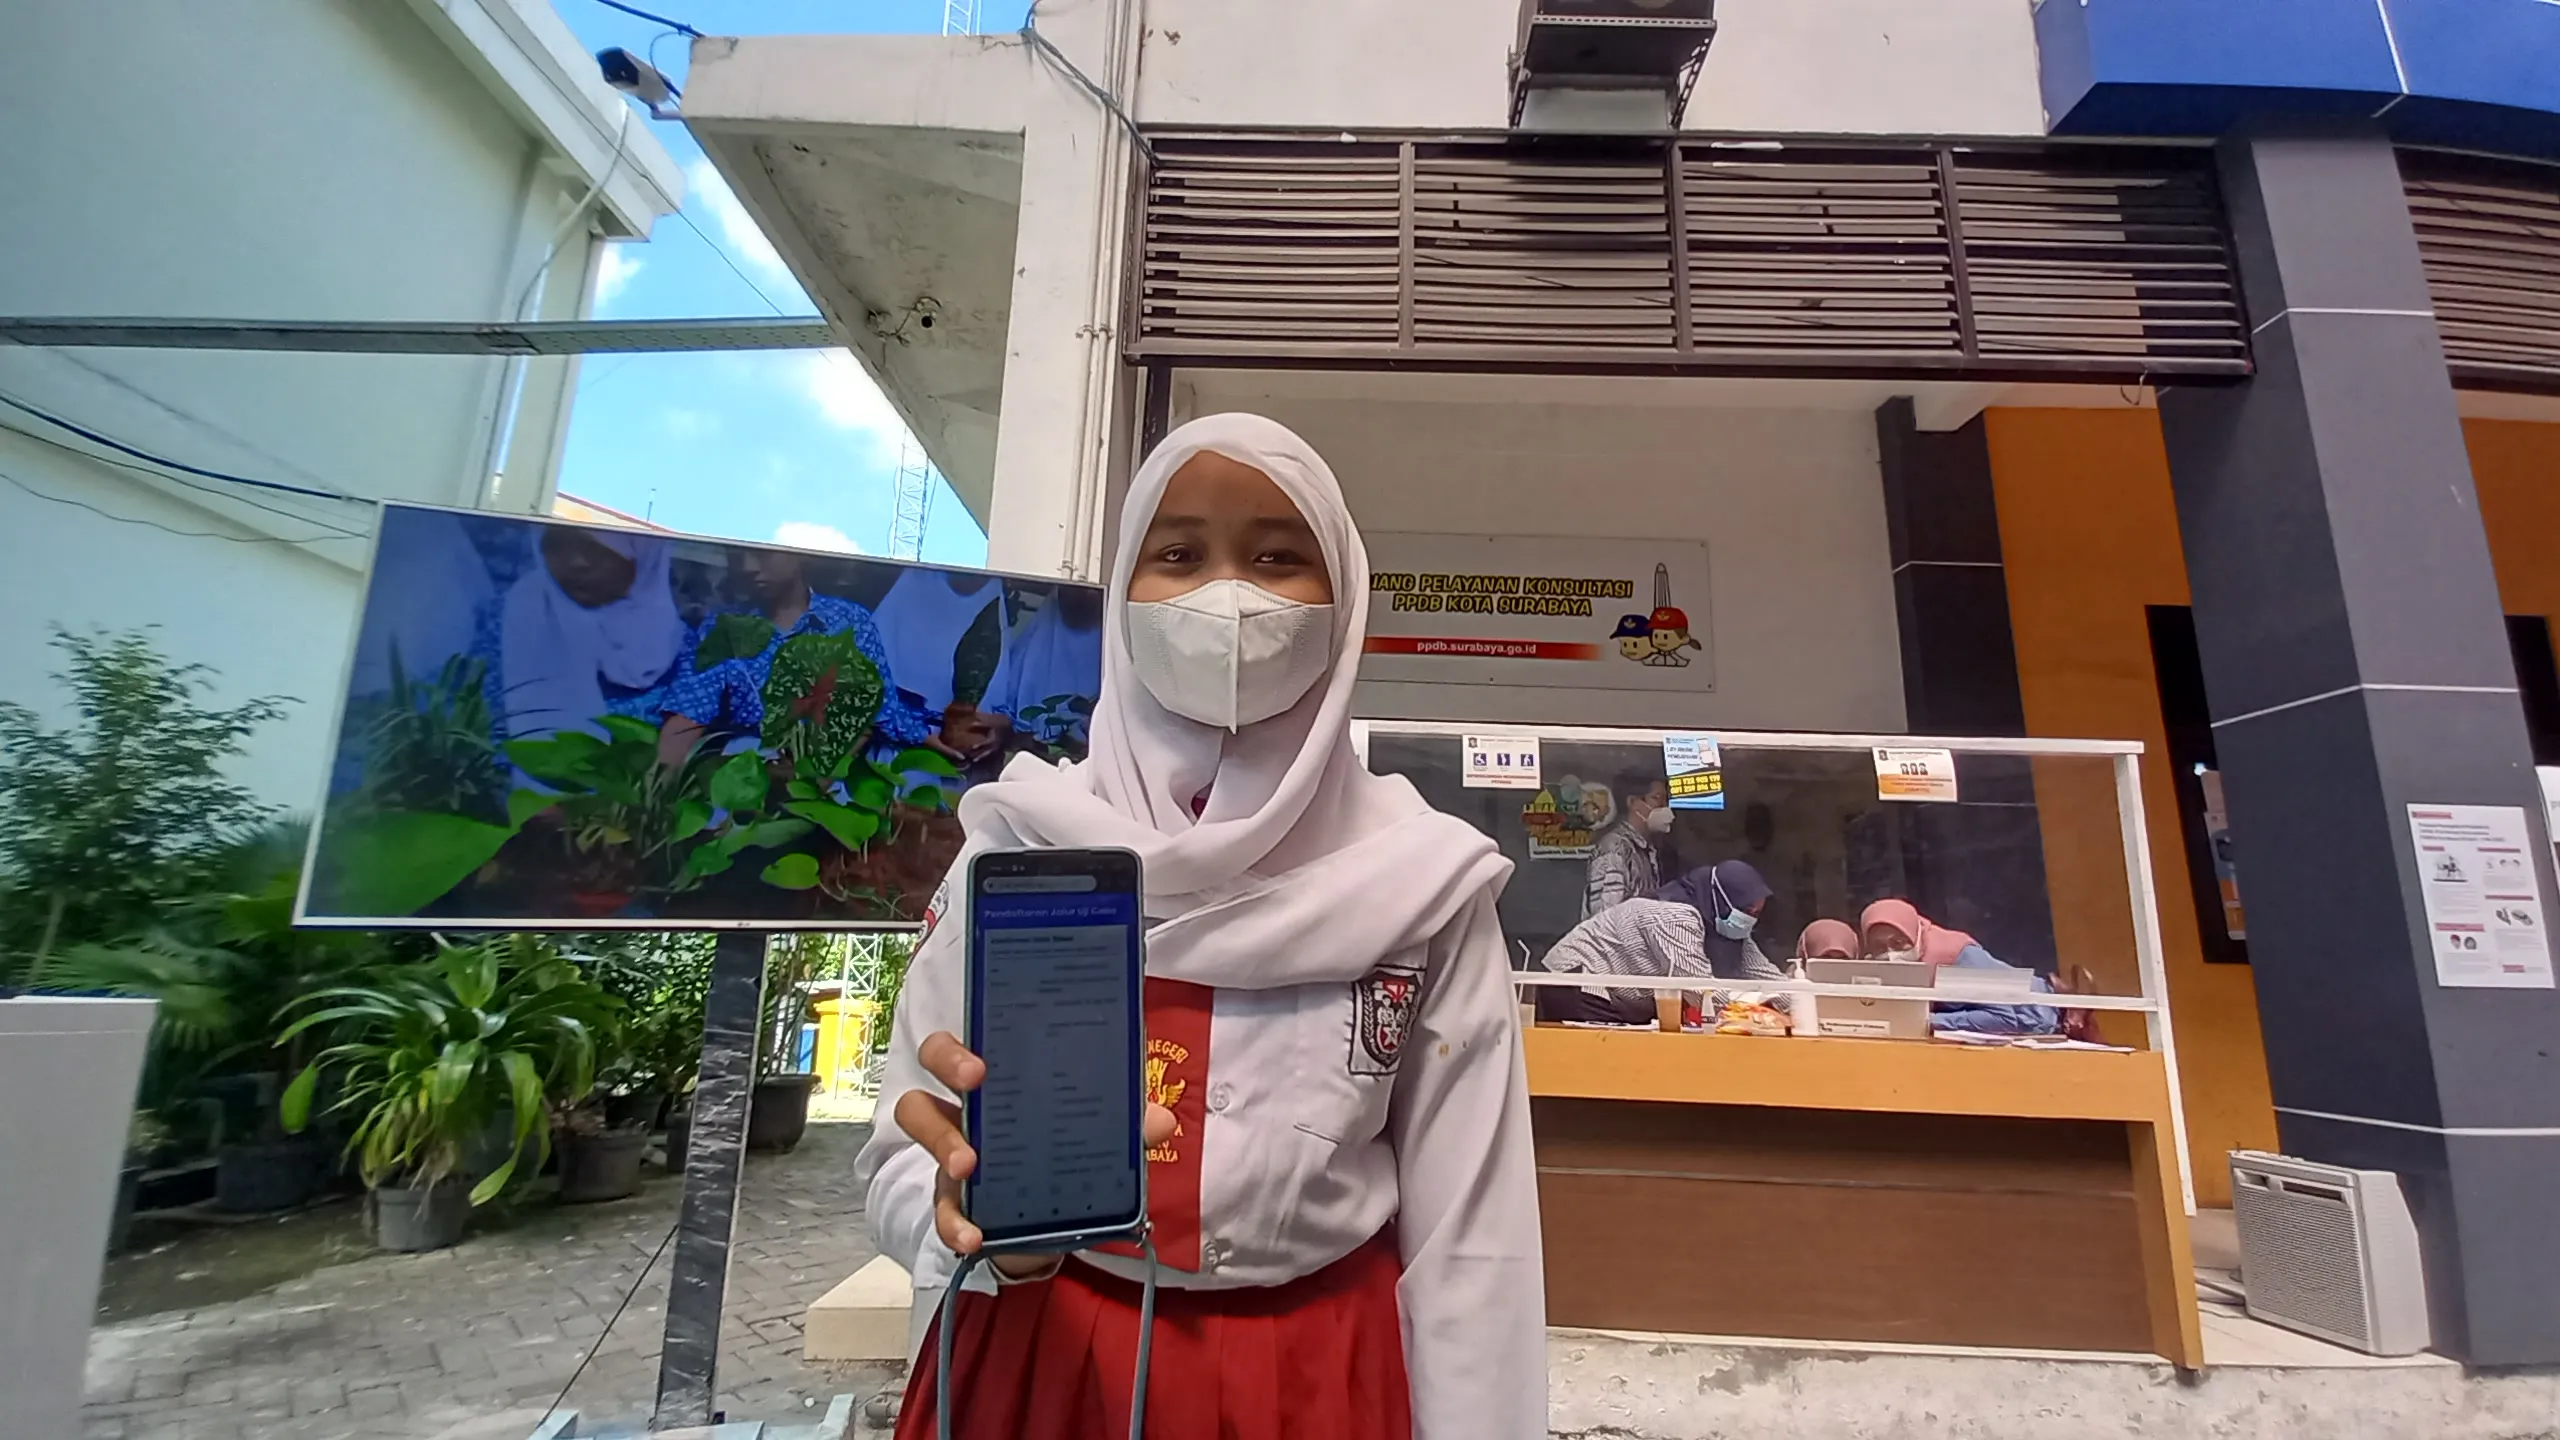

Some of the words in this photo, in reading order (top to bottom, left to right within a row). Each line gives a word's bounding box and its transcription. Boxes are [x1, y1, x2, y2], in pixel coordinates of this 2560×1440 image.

[1371, 573, 1416, 591] ANG
[1420, 574, 1519, 593] PELAYANAN
[1524, 577, 1632, 598] KONSULTASI
[1393, 594, 1442, 612] PPDB
[1447, 595, 1493, 614] KOTA
[1498, 596, 1592, 616] SURABAYA
[1416, 641, 1537, 656] ppdb.surabaya.go.id
[1147, 1038, 1190, 1065] NEGERI
[1146, 1148, 1178, 1162] BAYA
